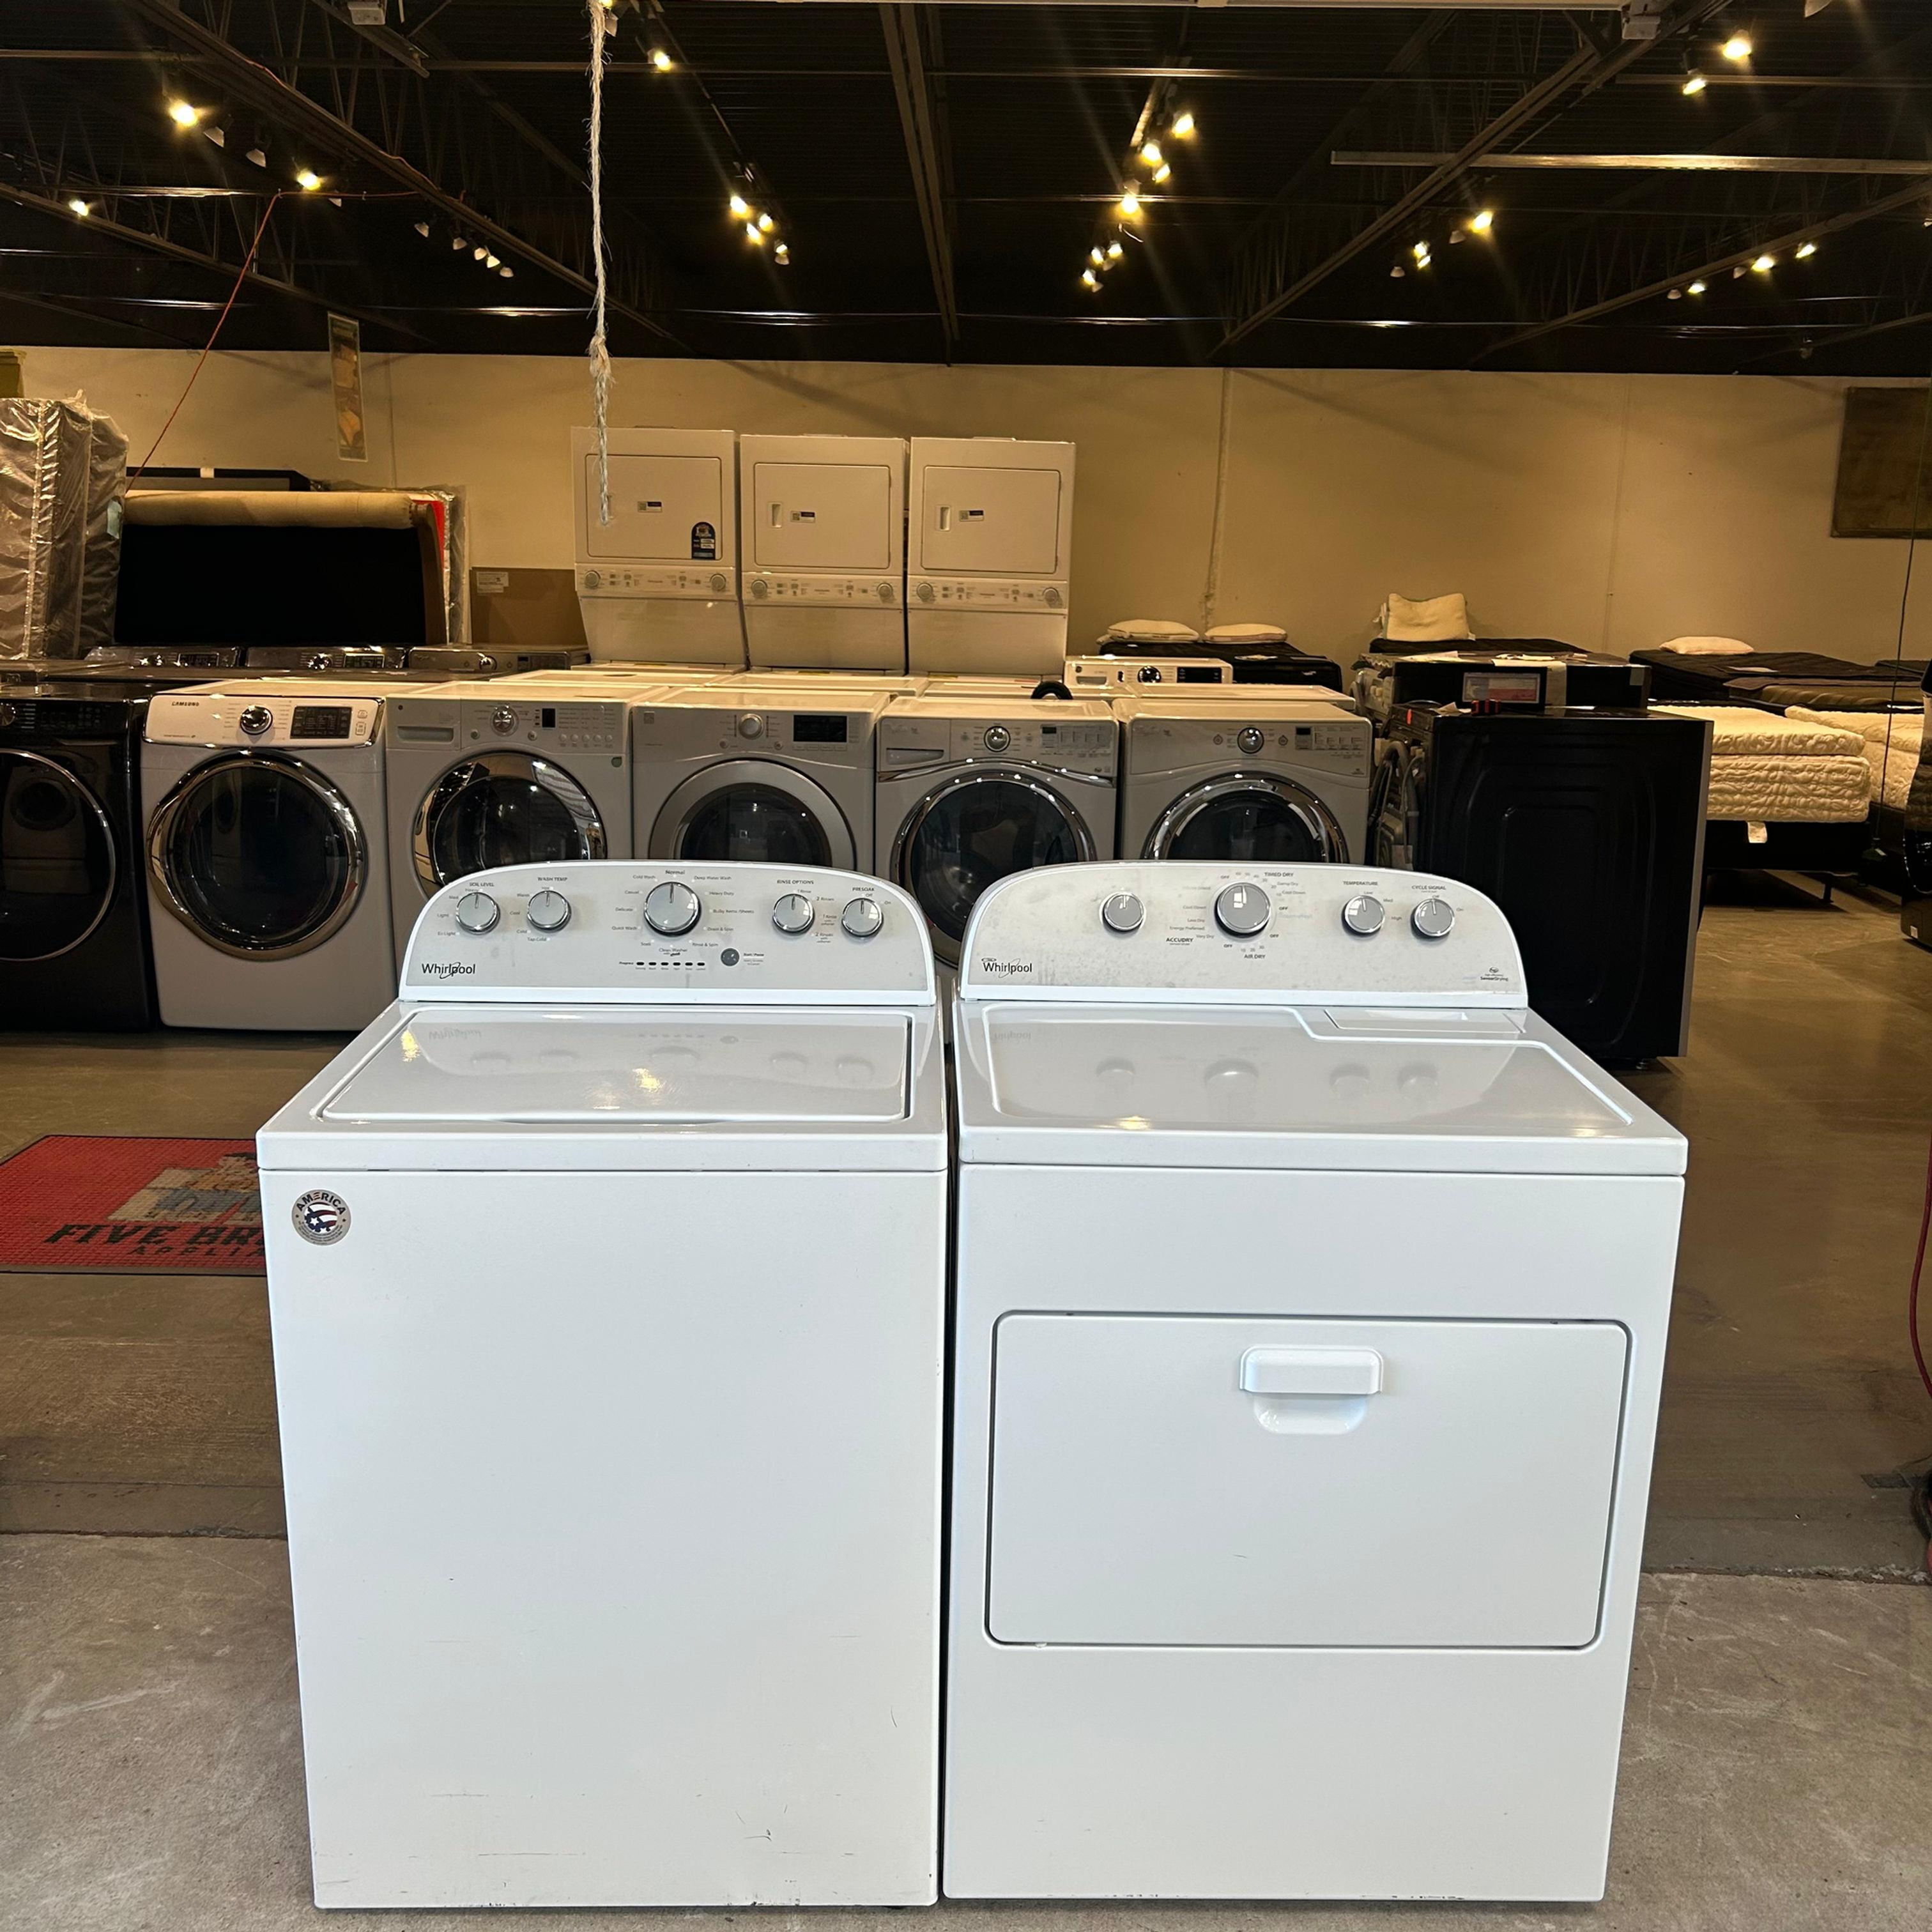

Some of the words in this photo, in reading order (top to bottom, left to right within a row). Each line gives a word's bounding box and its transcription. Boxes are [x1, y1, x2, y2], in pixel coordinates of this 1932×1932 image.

[422, 963, 475, 978] Whirlpool
[983, 961, 1032, 976] Whirlpool
[296, 1192, 346, 1215] AMERICA
[43, 1225, 180, 1244] FIVE
